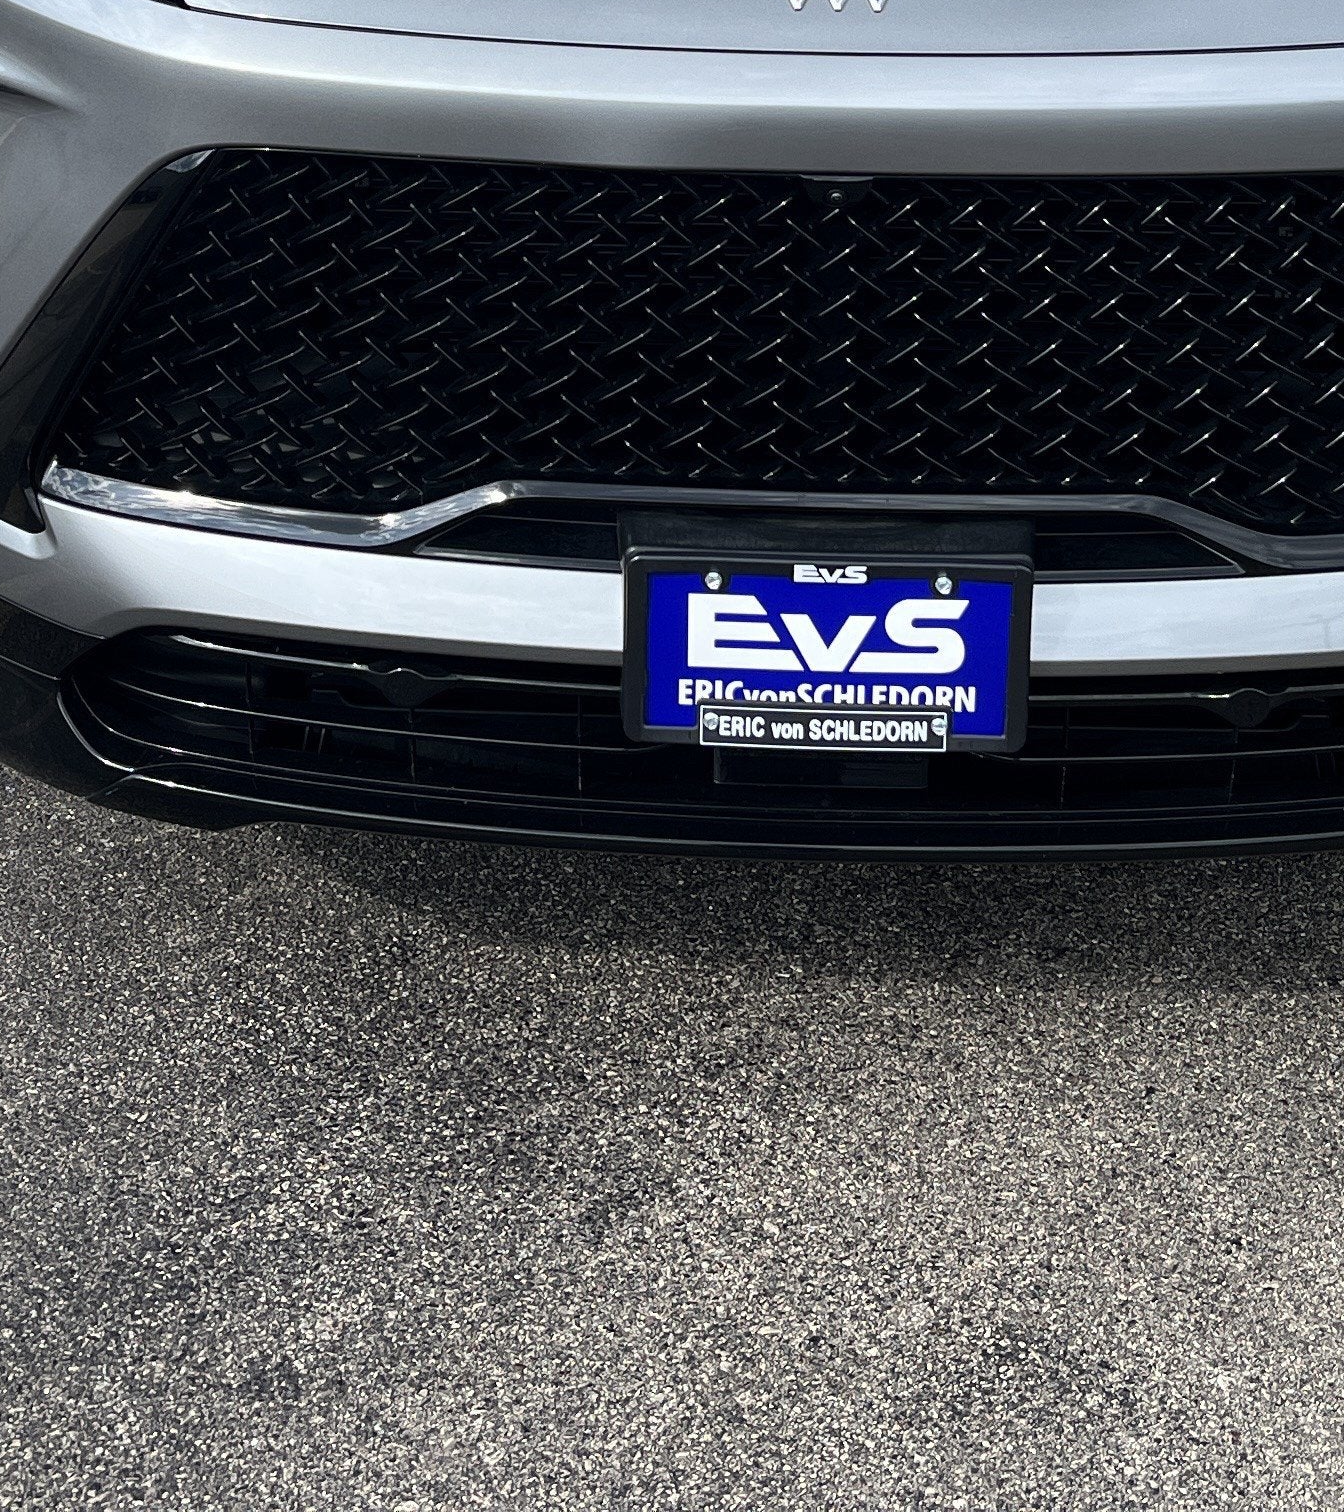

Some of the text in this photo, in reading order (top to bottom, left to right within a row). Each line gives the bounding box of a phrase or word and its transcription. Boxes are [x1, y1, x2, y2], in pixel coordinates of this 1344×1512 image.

[687, 592, 970, 674] EvS
[718, 715, 928, 742] ERIC von SCHLEDORN
